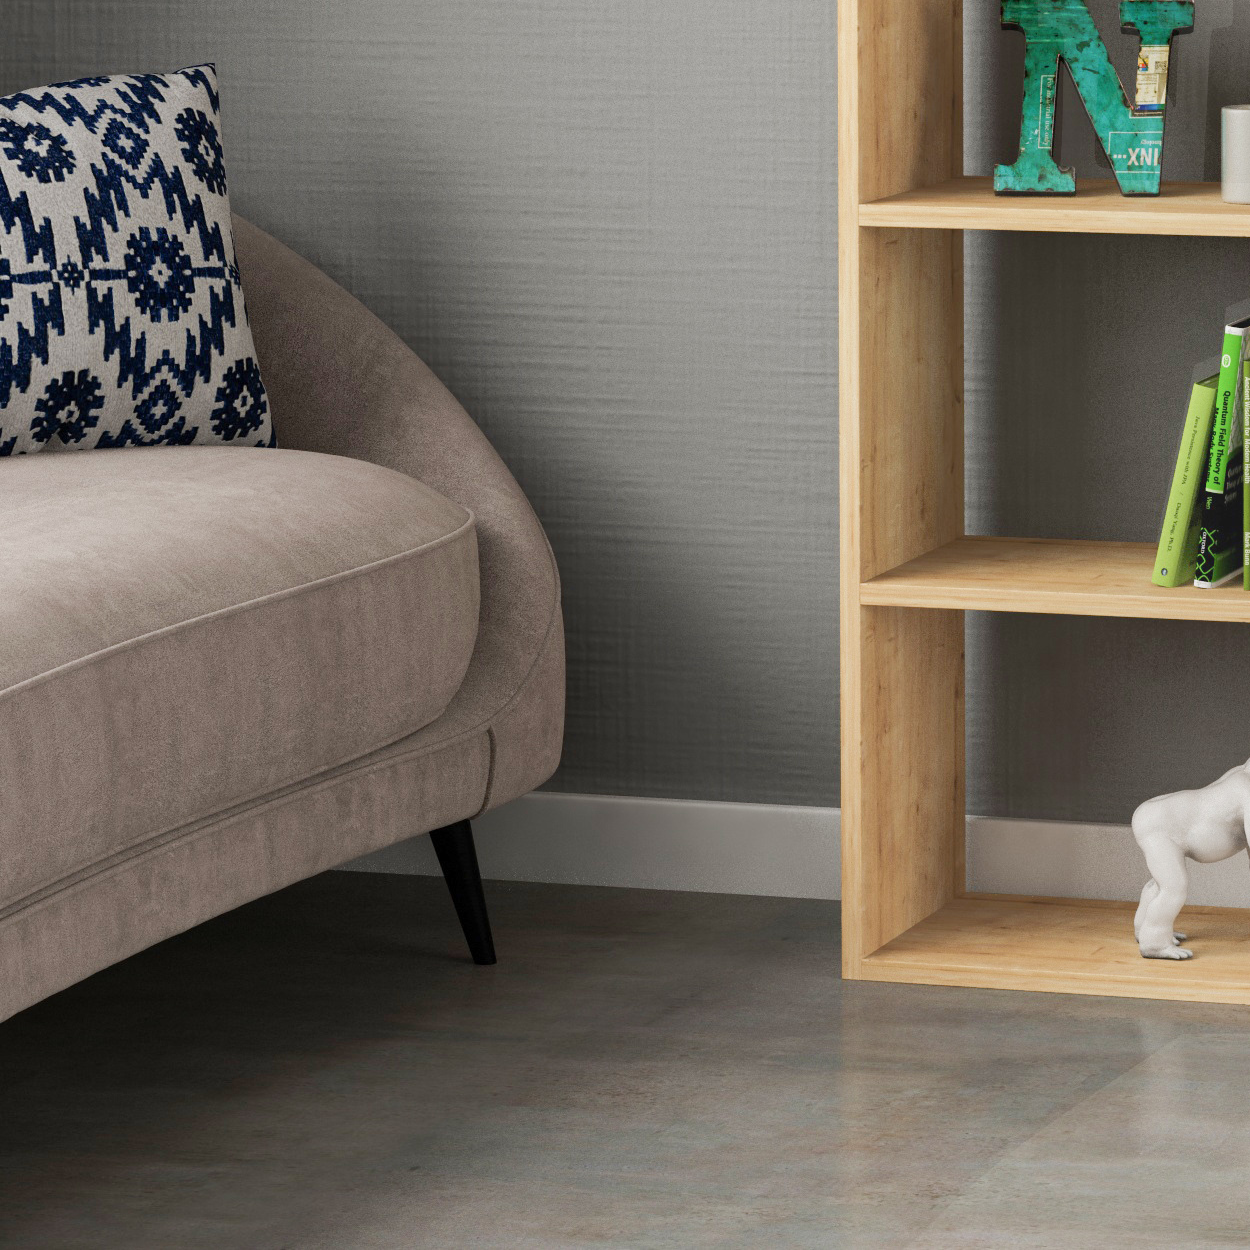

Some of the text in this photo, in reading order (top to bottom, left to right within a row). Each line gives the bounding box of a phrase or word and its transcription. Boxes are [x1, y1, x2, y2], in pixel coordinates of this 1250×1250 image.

[1213, 390, 1231, 485] Quantum Field Theory of
